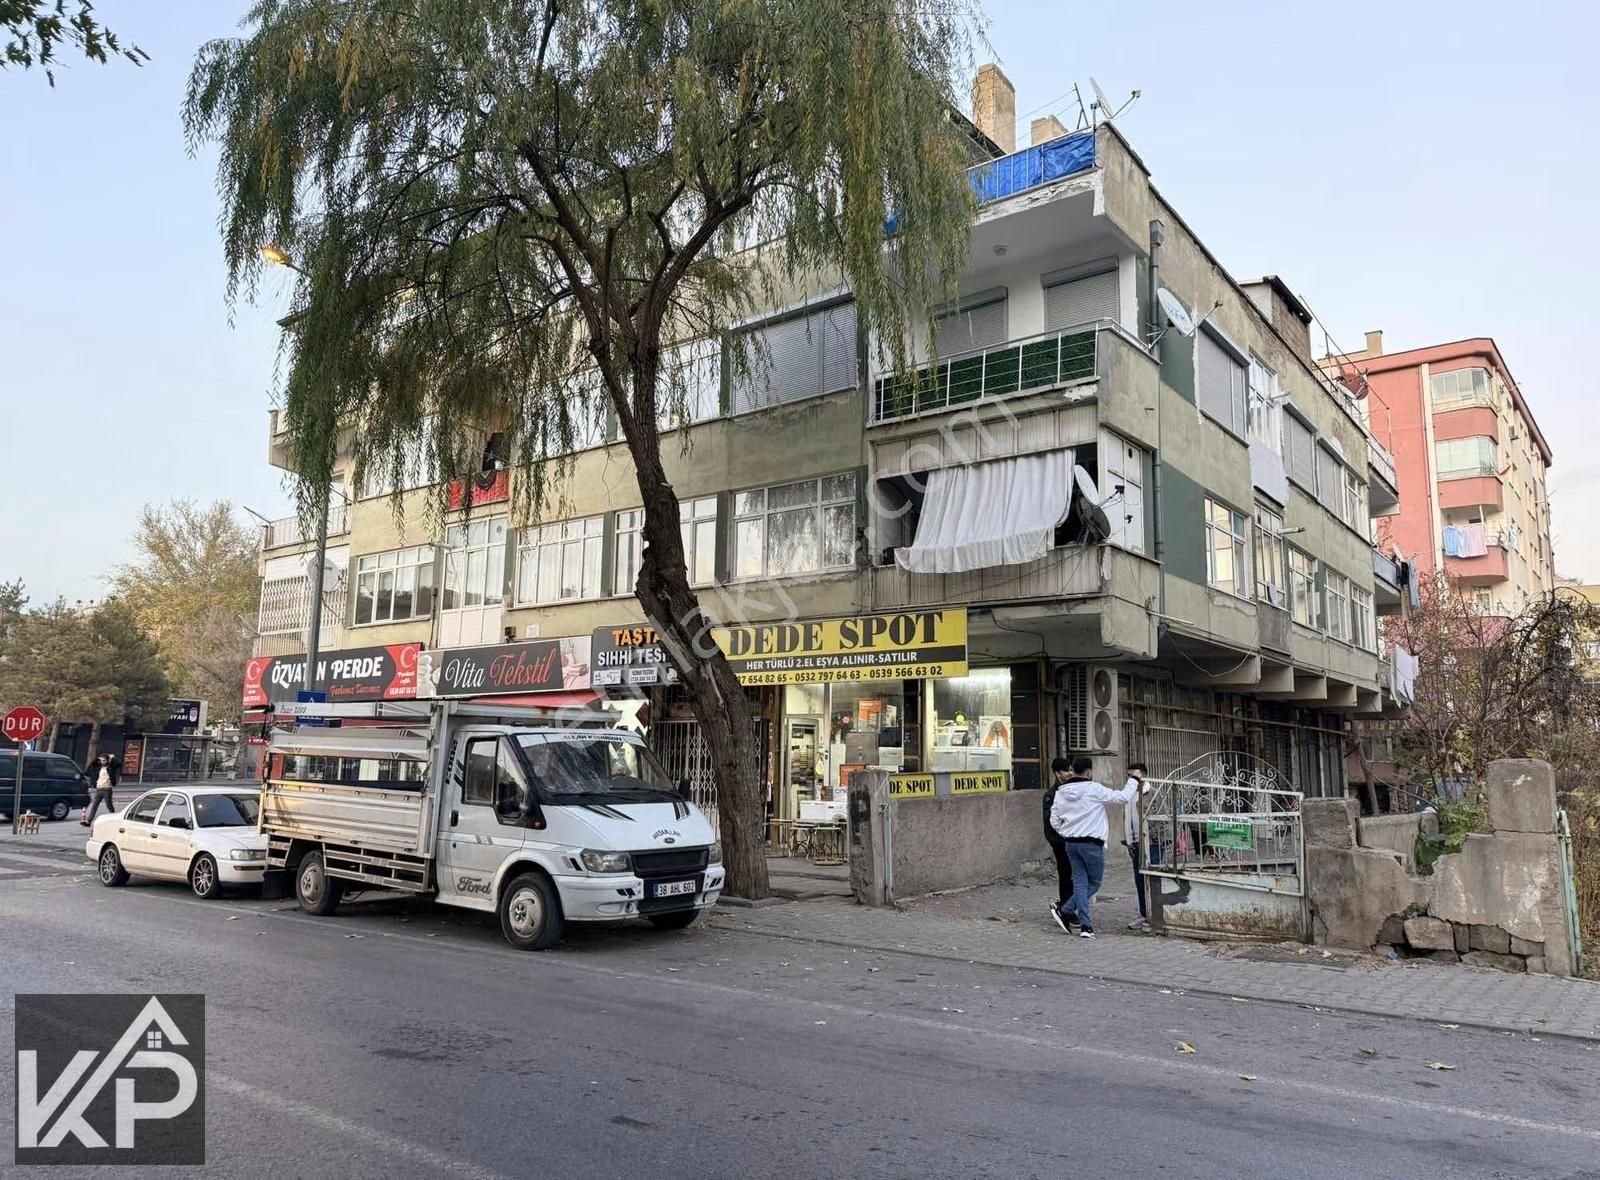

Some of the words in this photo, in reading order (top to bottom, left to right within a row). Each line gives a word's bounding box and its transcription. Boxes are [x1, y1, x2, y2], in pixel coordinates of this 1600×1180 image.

[612, 627, 661, 646] TAŞTA
[727, 622, 824, 656] DEDE
[839, 611, 943, 650] SPOT
[598, 646, 632, 666] SIHHİ
[746, 661, 763, 670] HER
[765, 656, 794, 669] TÜRLÜ
[796, 658, 814, 668] 2.EL
[816, 656, 839, 669] EŞYA
[841, 651, 918, 666] ALINIR-SATILIR
[271, 659, 327, 688] ÖZVATN
[330, 656, 384, 680] PERDE
[445, 657, 486, 688] Vita
[489, 647, 557, 687] Tekstil
[748, 675, 763, 684] 654
[765, 674, 775, 683] 82
[777, 673, 787, 682] 65
[795, 672, 816, 682] 0532
[818, 671, 834, 680] 797
[836, 670, 847, 680] 64
[850, 670, 860, 679] 63
[869, 668, 892, 678] 0539
[895, 667, 913, 677] 566
[915, 666, 927, 676] 63
[930, 665, 943, 675] 02
[5, 716, 42, 732] DUR
[889, 780, 903, 794] DE
[906, 779, 932, 793] SPOT
[954, 777, 979, 790] DEDE
[981, 776, 1003, 789] SPOT
[456, 876, 492, 896] Ford
[659, 884, 667, 896] 38
[683, 881, 695, 892] 602
